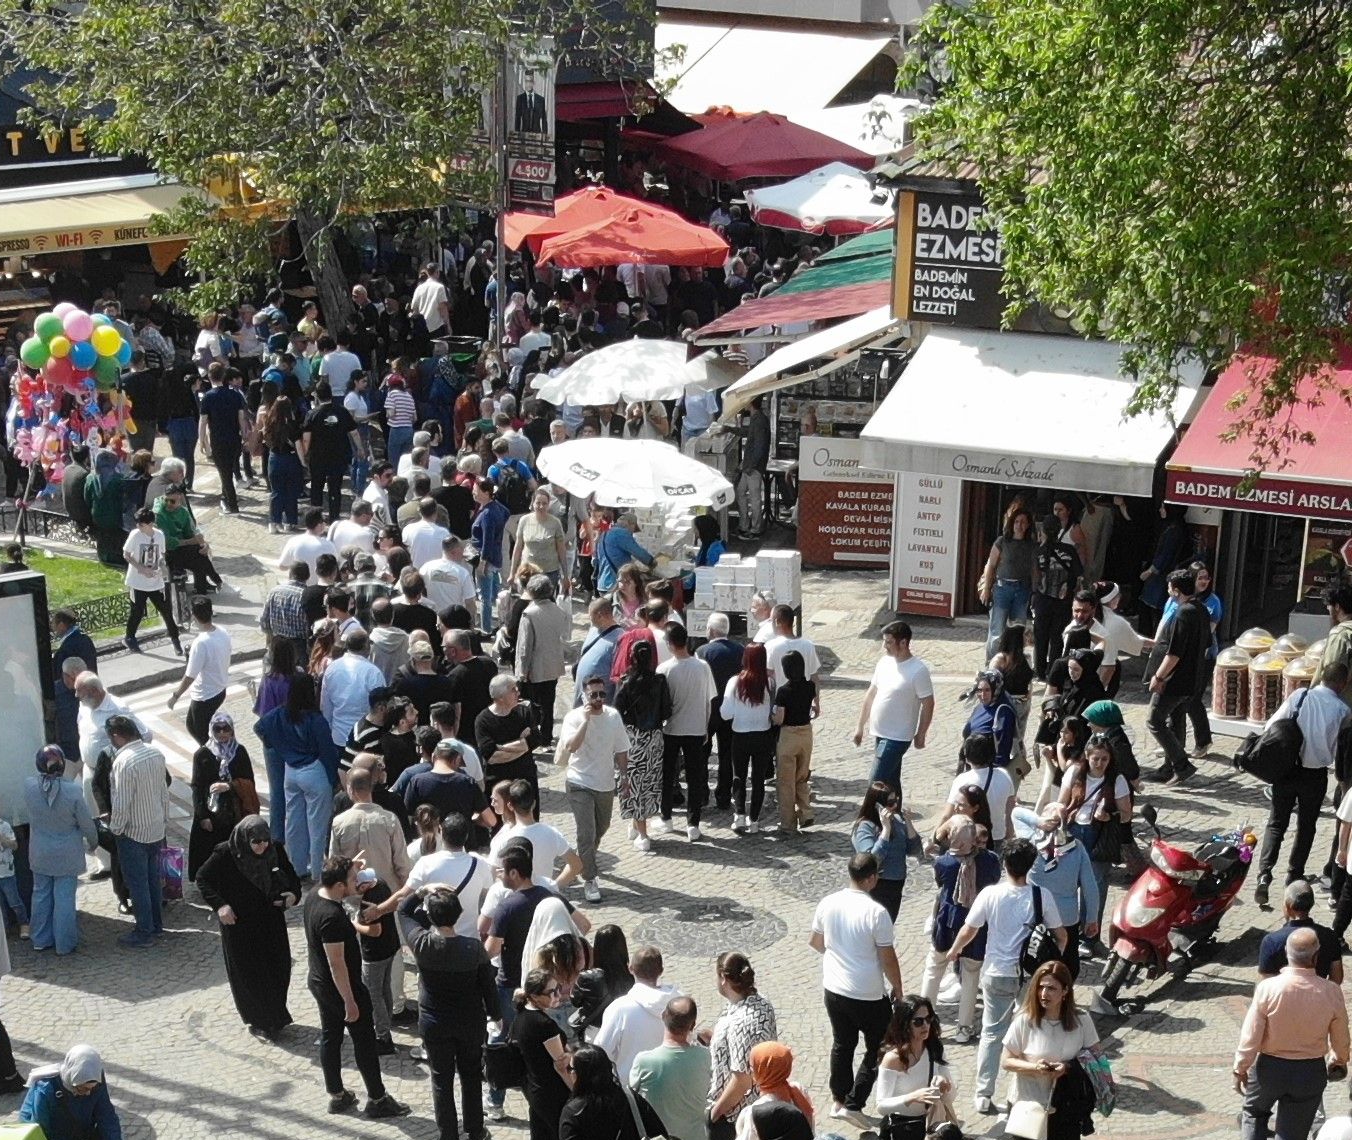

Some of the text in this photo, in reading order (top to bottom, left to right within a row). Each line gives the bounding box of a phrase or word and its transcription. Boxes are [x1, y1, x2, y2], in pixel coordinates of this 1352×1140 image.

[55, 232, 83, 248] WI-FI
[914, 267, 968, 284] BADEMİN
[913, 284, 975, 301] EN DOĞAL
[913, 299, 957, 316] LEZZETİ
[1175, 481, 1231, 499] BADEM
[825, 502, 860, 511] KAVALA
[916, 511, 941, 521] ANTEP
